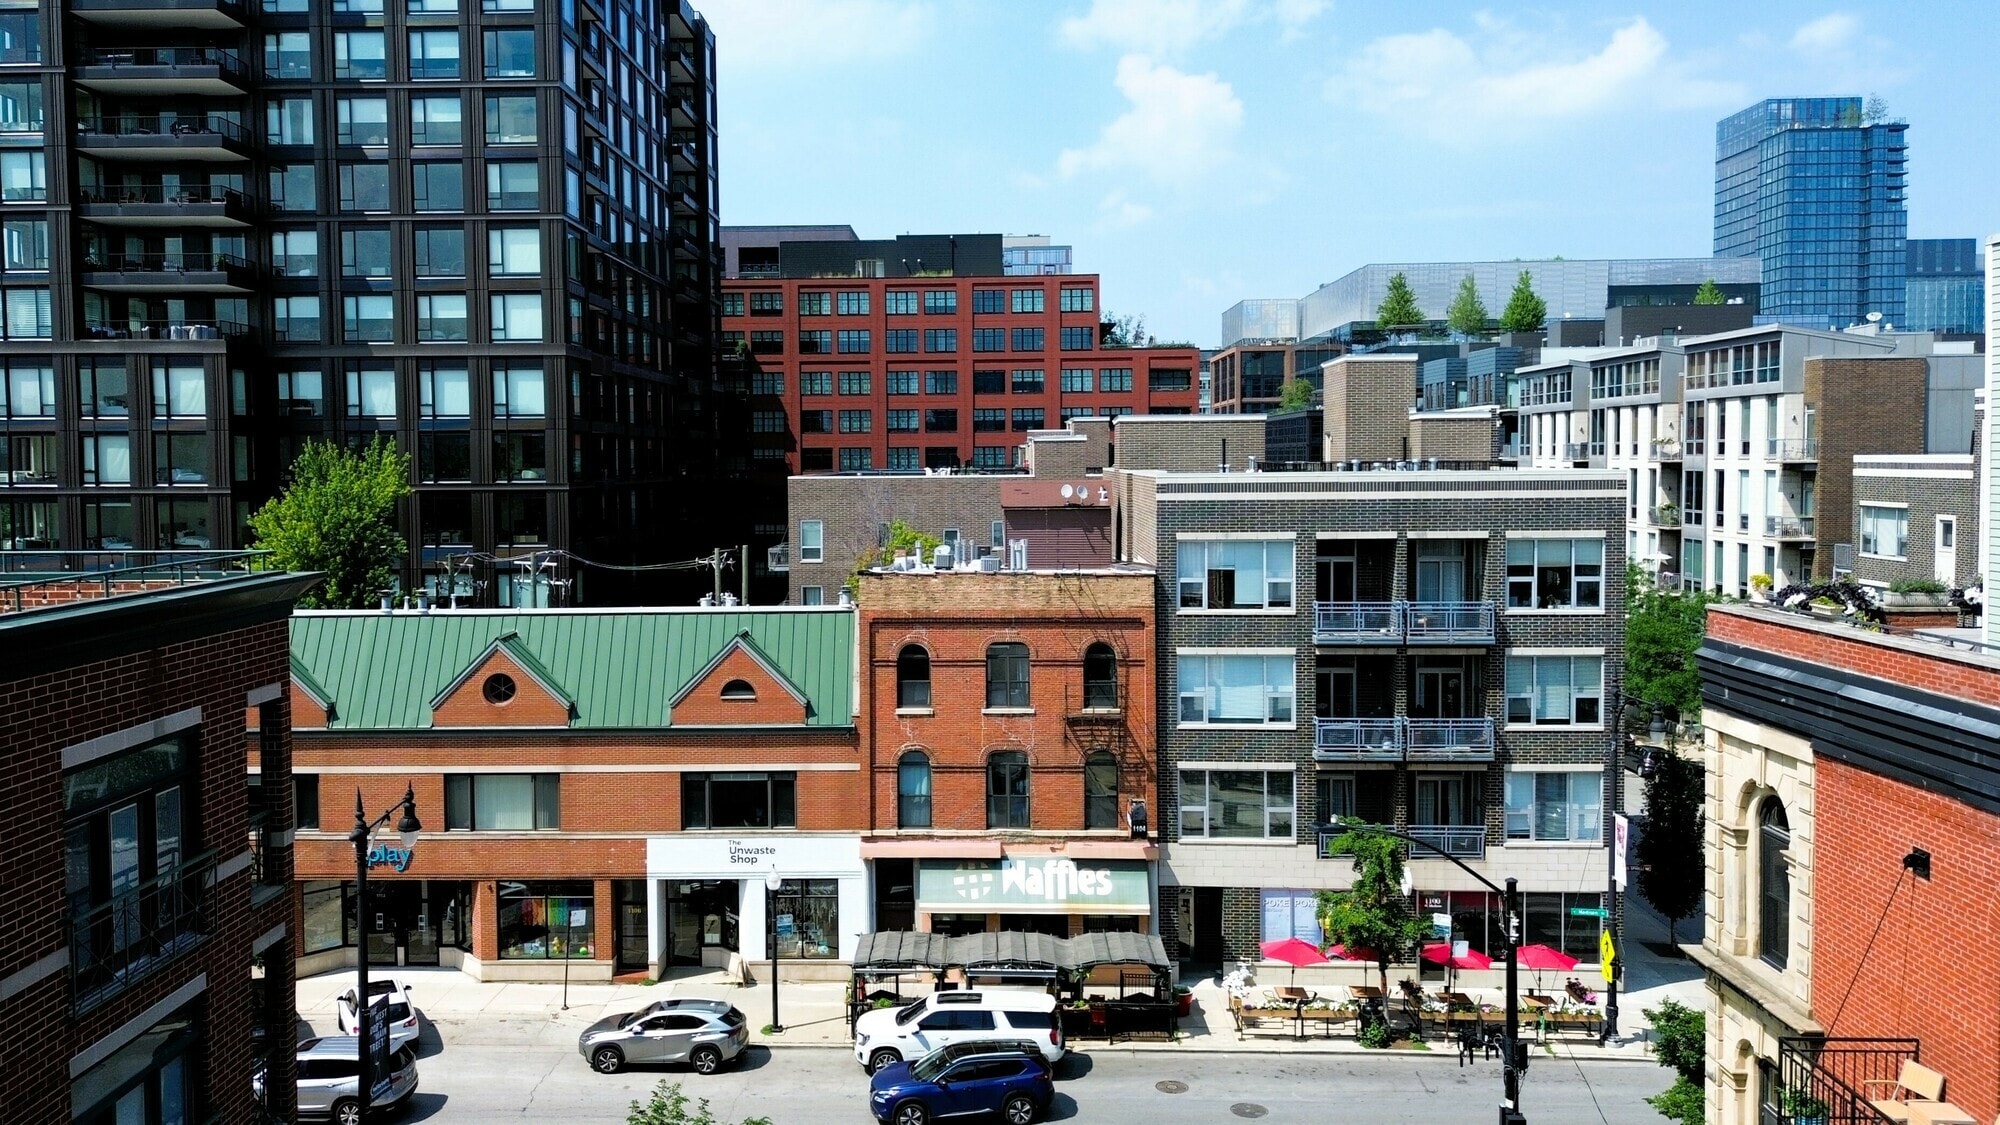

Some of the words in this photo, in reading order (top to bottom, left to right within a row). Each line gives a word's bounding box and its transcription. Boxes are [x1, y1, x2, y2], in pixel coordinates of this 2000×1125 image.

[729, 846, 776, 855] Unwaste
[368, 844, 412, 871] play
[730, 855, 758, 865] Shop
[1001, 859, 1113, 900] Waffles
[1263, 899, 1290, 908] POKE
